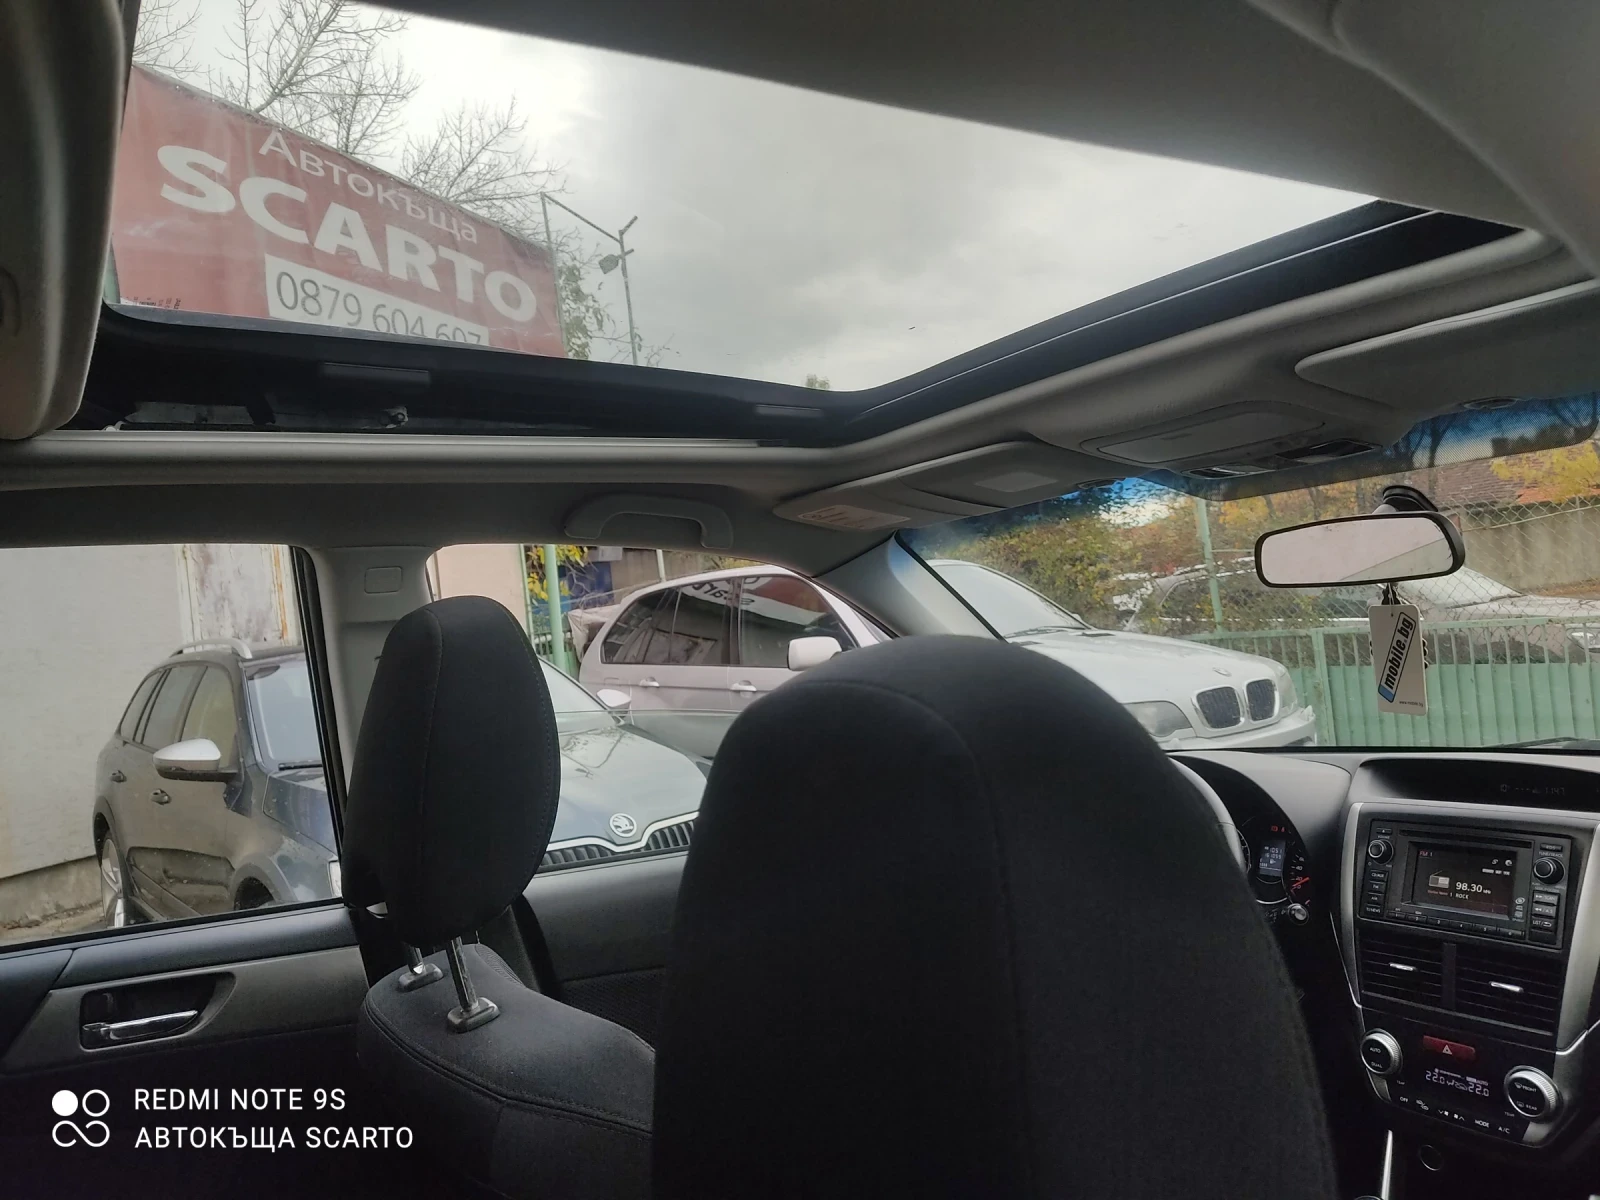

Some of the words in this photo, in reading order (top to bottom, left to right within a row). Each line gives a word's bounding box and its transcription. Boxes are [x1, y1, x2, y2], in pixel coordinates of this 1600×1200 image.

[259, 130, 478, 244] Автокъща
[157, 145, 538, 322] SCARTO
[276, 271, 362, 327] 0879
[373, 304, 427, 337] 604
[1384, 617, 1414, 690] mobile.bg
[1455, 881, 1483, 893] 98.30
[1425, 1070, 1445, 1084] 22.0
[1468, 1082, 1489, 1096] 22.0
[1474, 1119, 1490, 1129] MODE
[1498, 1126, 1510, 1134] A/C
